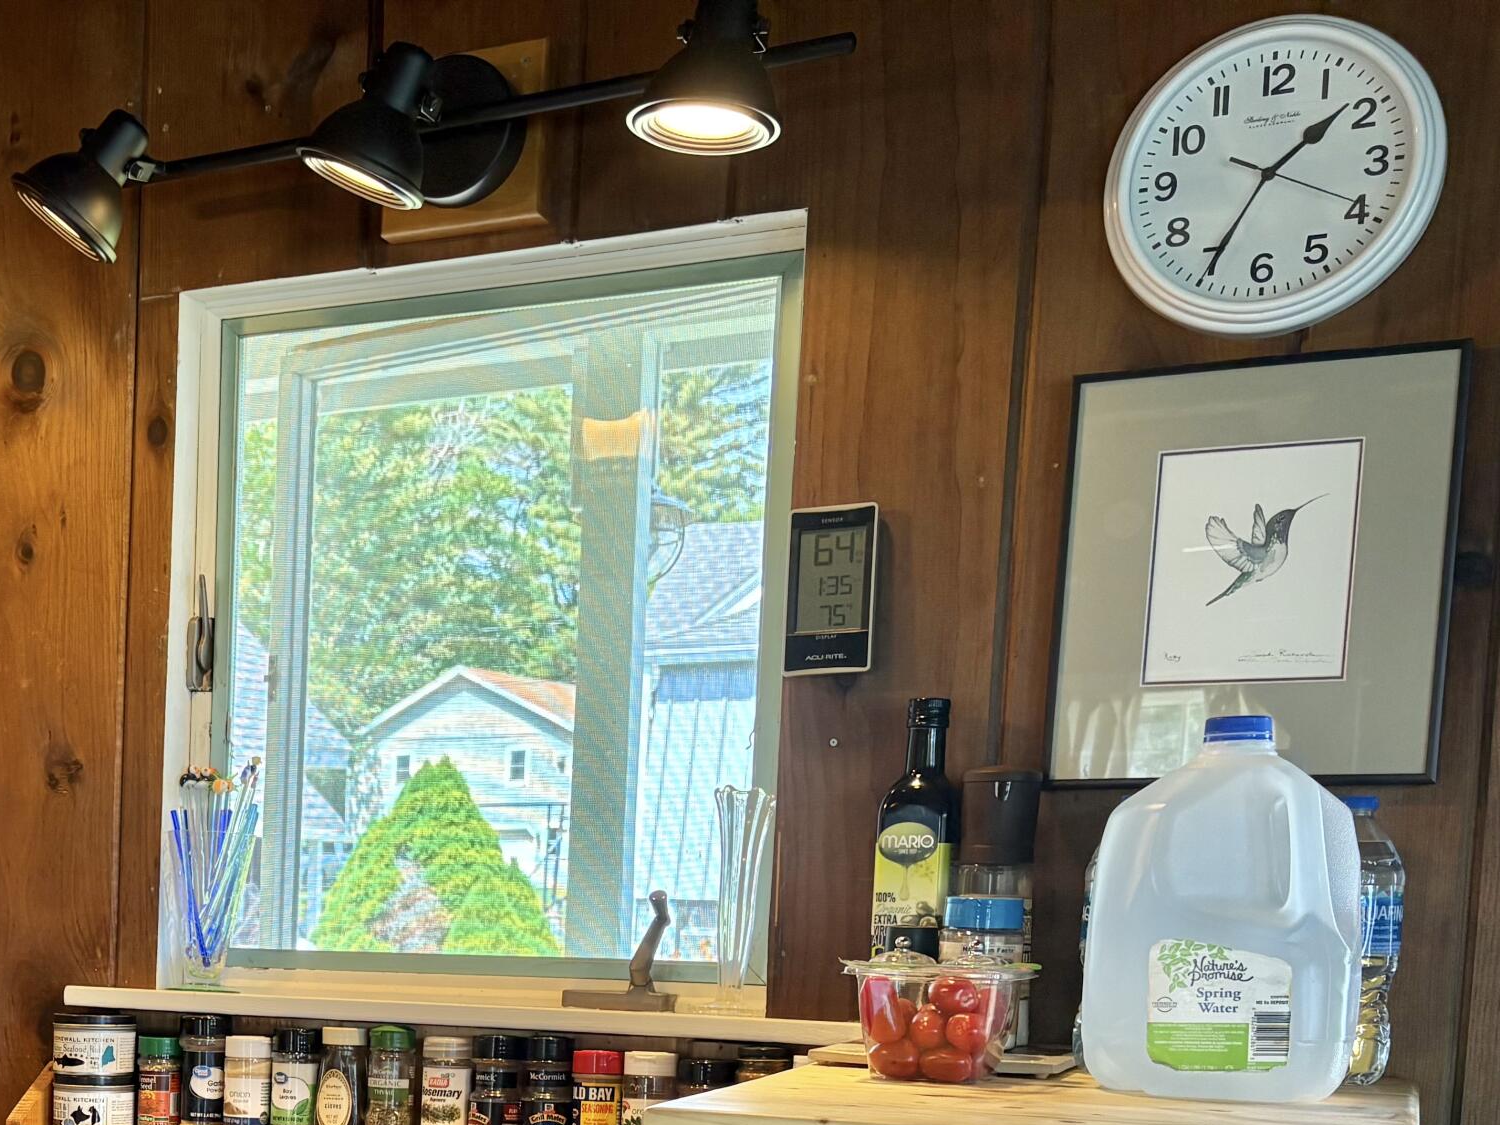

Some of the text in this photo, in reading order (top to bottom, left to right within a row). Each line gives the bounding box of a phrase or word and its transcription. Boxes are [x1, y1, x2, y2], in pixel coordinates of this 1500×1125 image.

[1262, 64, 1296, 97] 12
[1321, 68, 1330, 100] 1
[1213, 85, 1230, 117] 11
[1351, 97, 1378, 130] 2
[1172, 124, 1206, 156] 10
[1363, 145, 1389, 177] 3
[1154, 171, 1178, 202] 9
[1343, 194, 1369, 225] 4
[1165, 217, 1190, 247] 8
[1303, 233, 1329, 264] 5
[1249, 253, 1274, 283] 6
[818, 575, 852, 596] 1:35
[881, 834, 934, 849] MARIO
[875, 892, 896, 903] 100%
[873, 914, 898, 925] EXTRA
[1192, 956, 1248, 972] Nature's
[1188, 970, 1254, 986] Promise
[1196, 987, 1241, 1001] Spring
[1198, 1003, 1239, 1013] Water
[530, 1072, 566, 1081] McCormick
[422, 1087, 462, 1099] Rosemary
[573, 1087, 613, 1101] LD BAY
[581, 1104, 614, 1114] SEASONING
